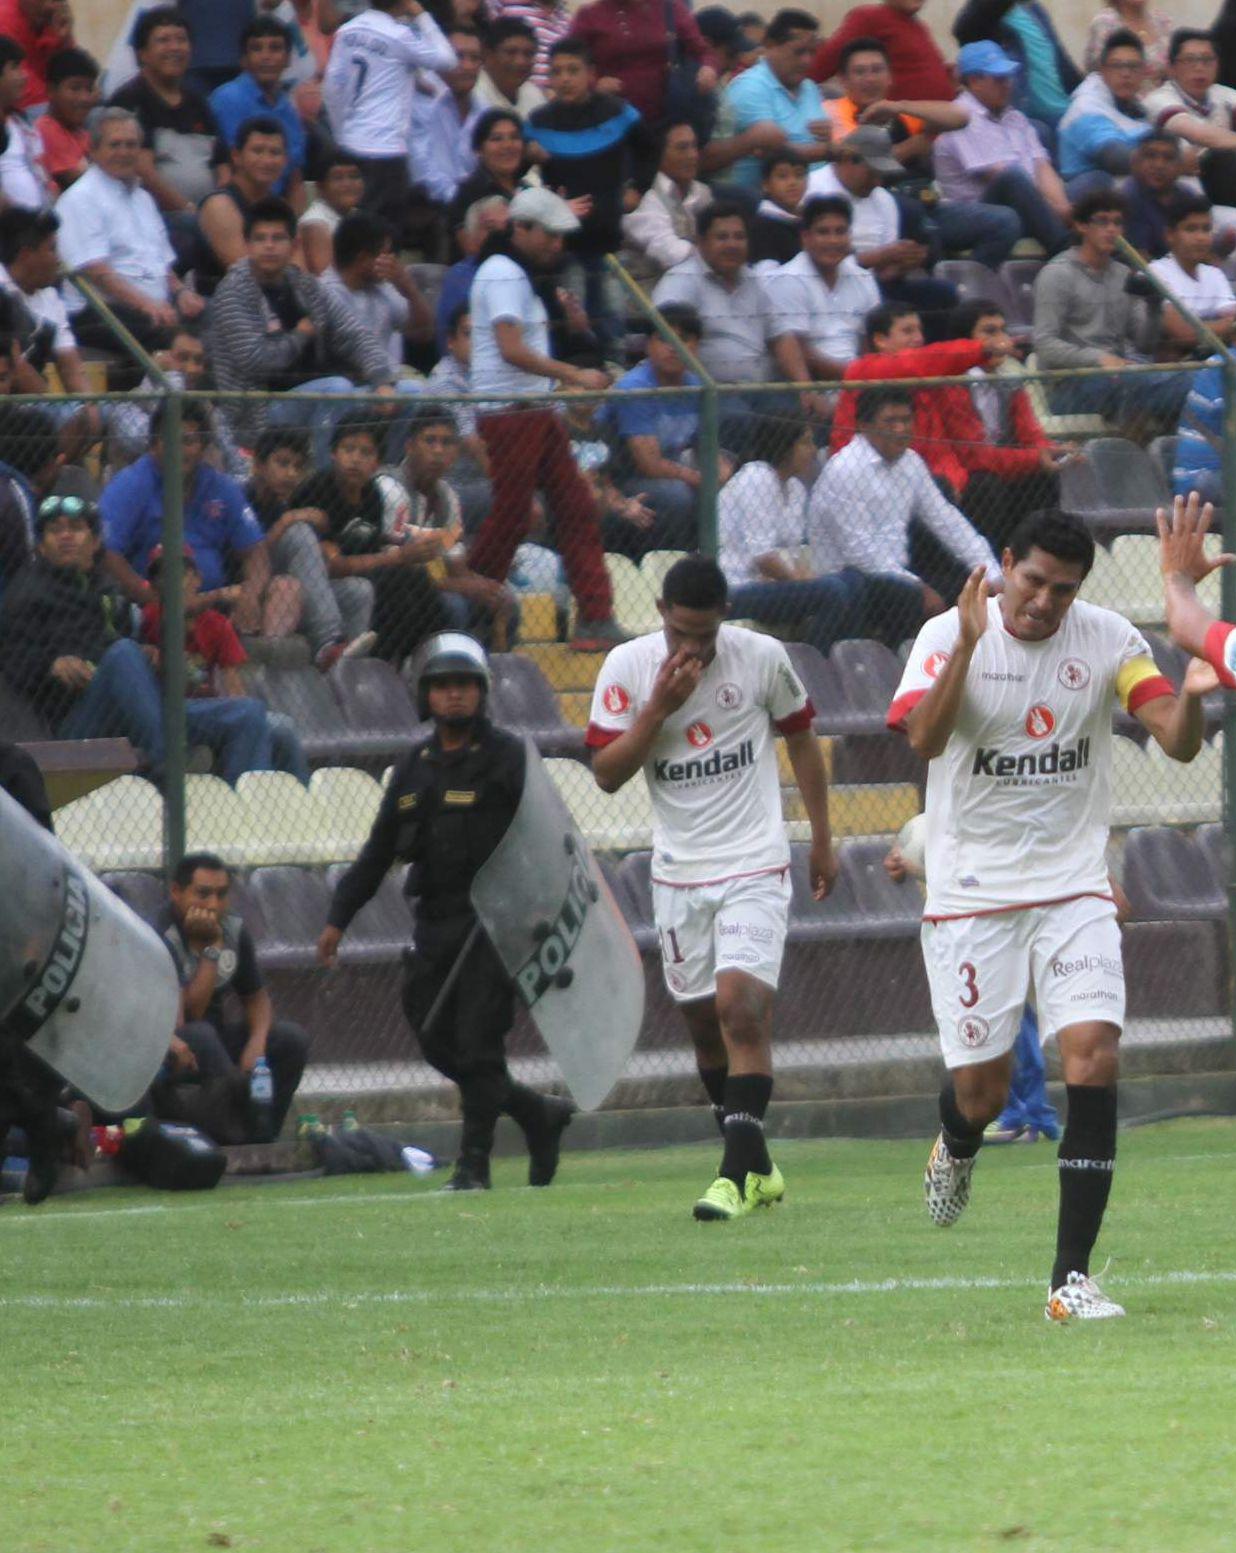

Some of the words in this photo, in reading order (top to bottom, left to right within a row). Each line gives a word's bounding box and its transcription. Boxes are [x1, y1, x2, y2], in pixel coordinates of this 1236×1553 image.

[654, 739, 755, 782] Kendall
[972, 739, 1089, 777] Kendall
[517, 850, 592, 1005] POLIC
[959, 962, 979, 1008] 3
